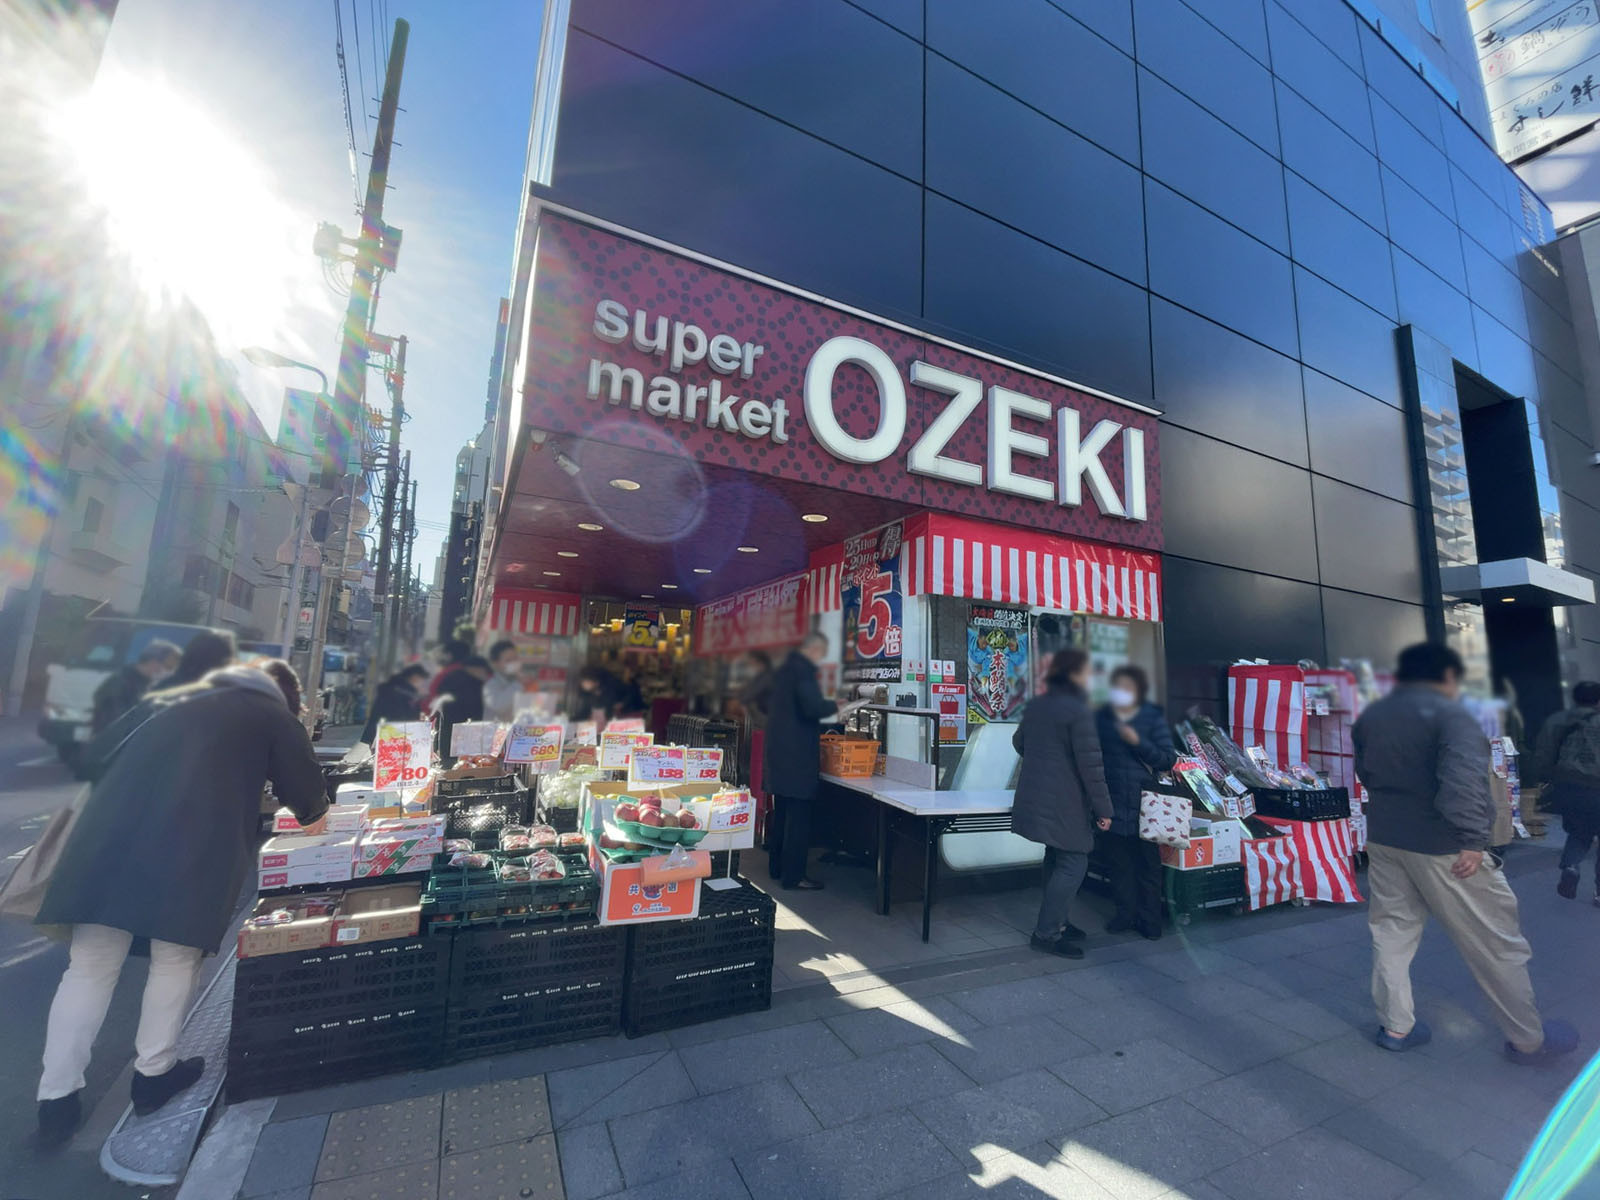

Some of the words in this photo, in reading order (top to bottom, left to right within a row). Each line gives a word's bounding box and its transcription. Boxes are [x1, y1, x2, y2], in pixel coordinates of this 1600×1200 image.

[593, 299, 764, 379] super
[587, 358, 790, 445] market
[803, 335, 1147, 521] OZEKI
[857, 571, 893, 659] 5
[885, 626, 902, 656] 倍
[530, 744, 554, 755] 680
